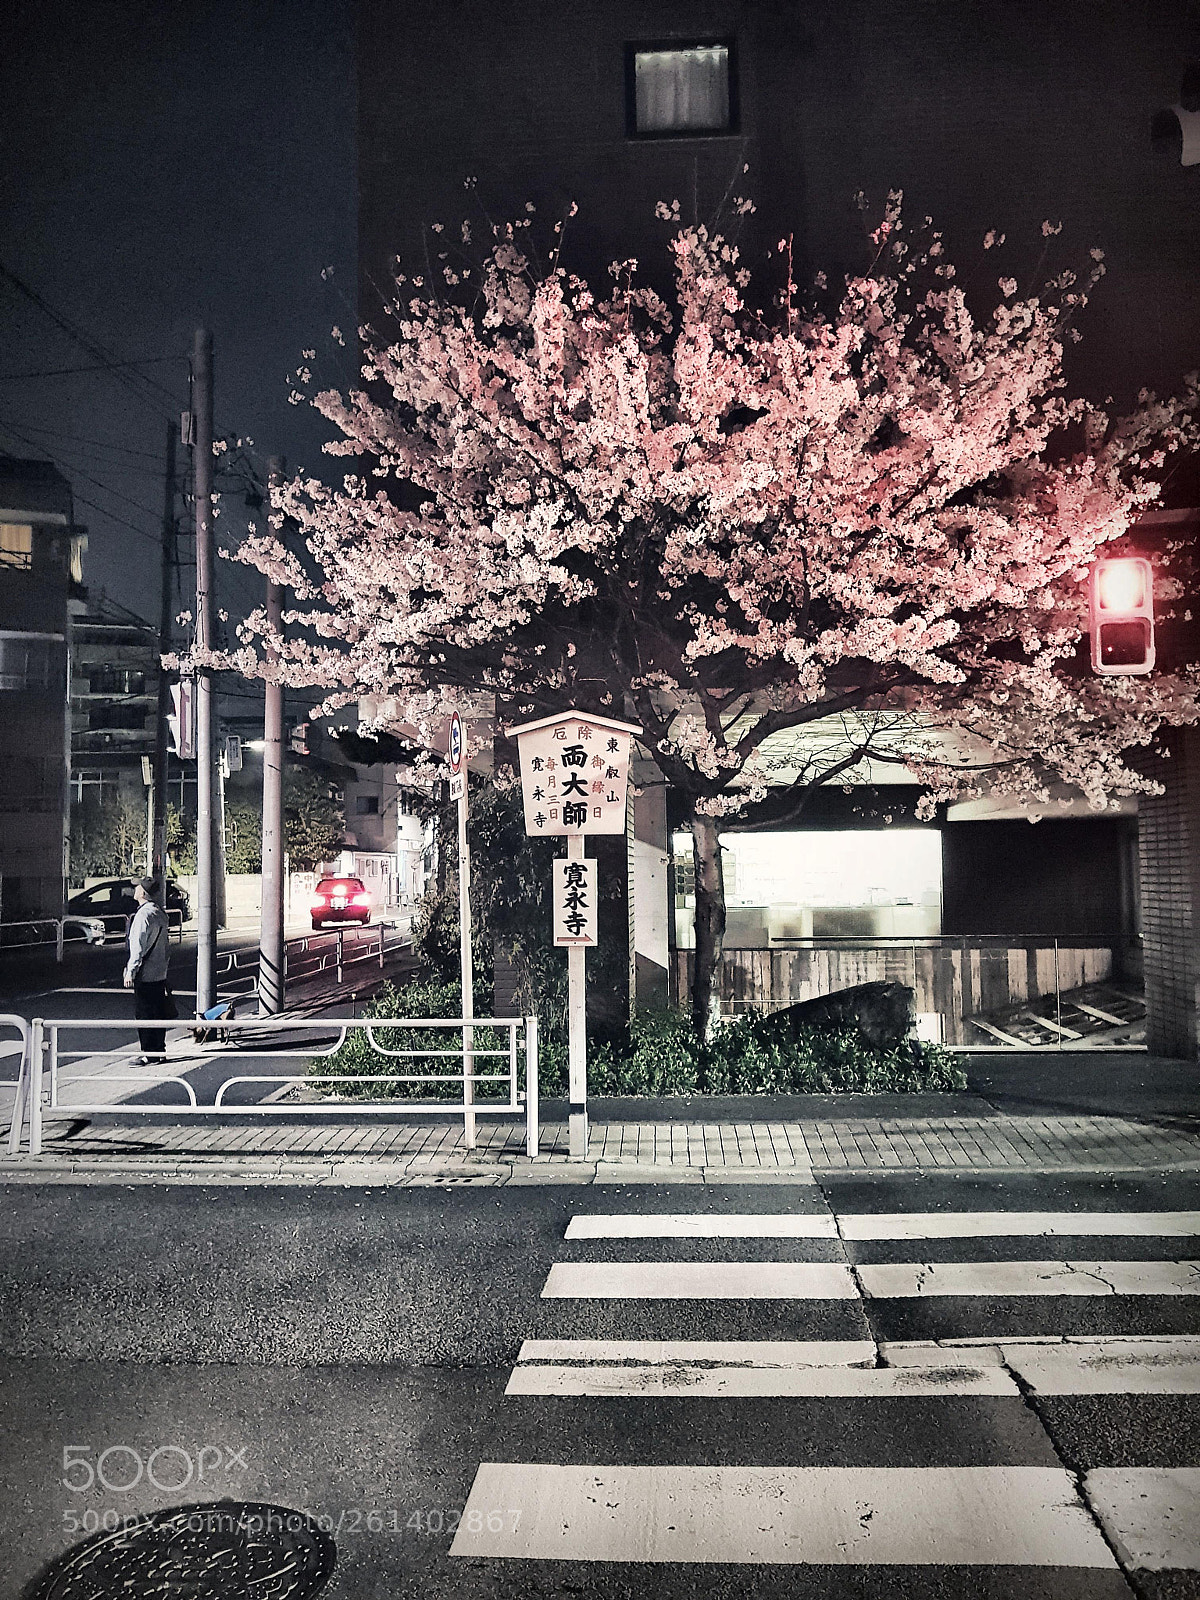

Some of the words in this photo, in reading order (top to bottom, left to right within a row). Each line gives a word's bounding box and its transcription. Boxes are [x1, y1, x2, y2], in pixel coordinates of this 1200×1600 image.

[531, 757, 547, 828] 寛永寺
[560, 745, 589, 828] 両大師
[605, 738, 620, 803] 東叡山
[562, 862, 590, 936] 寛永寺
